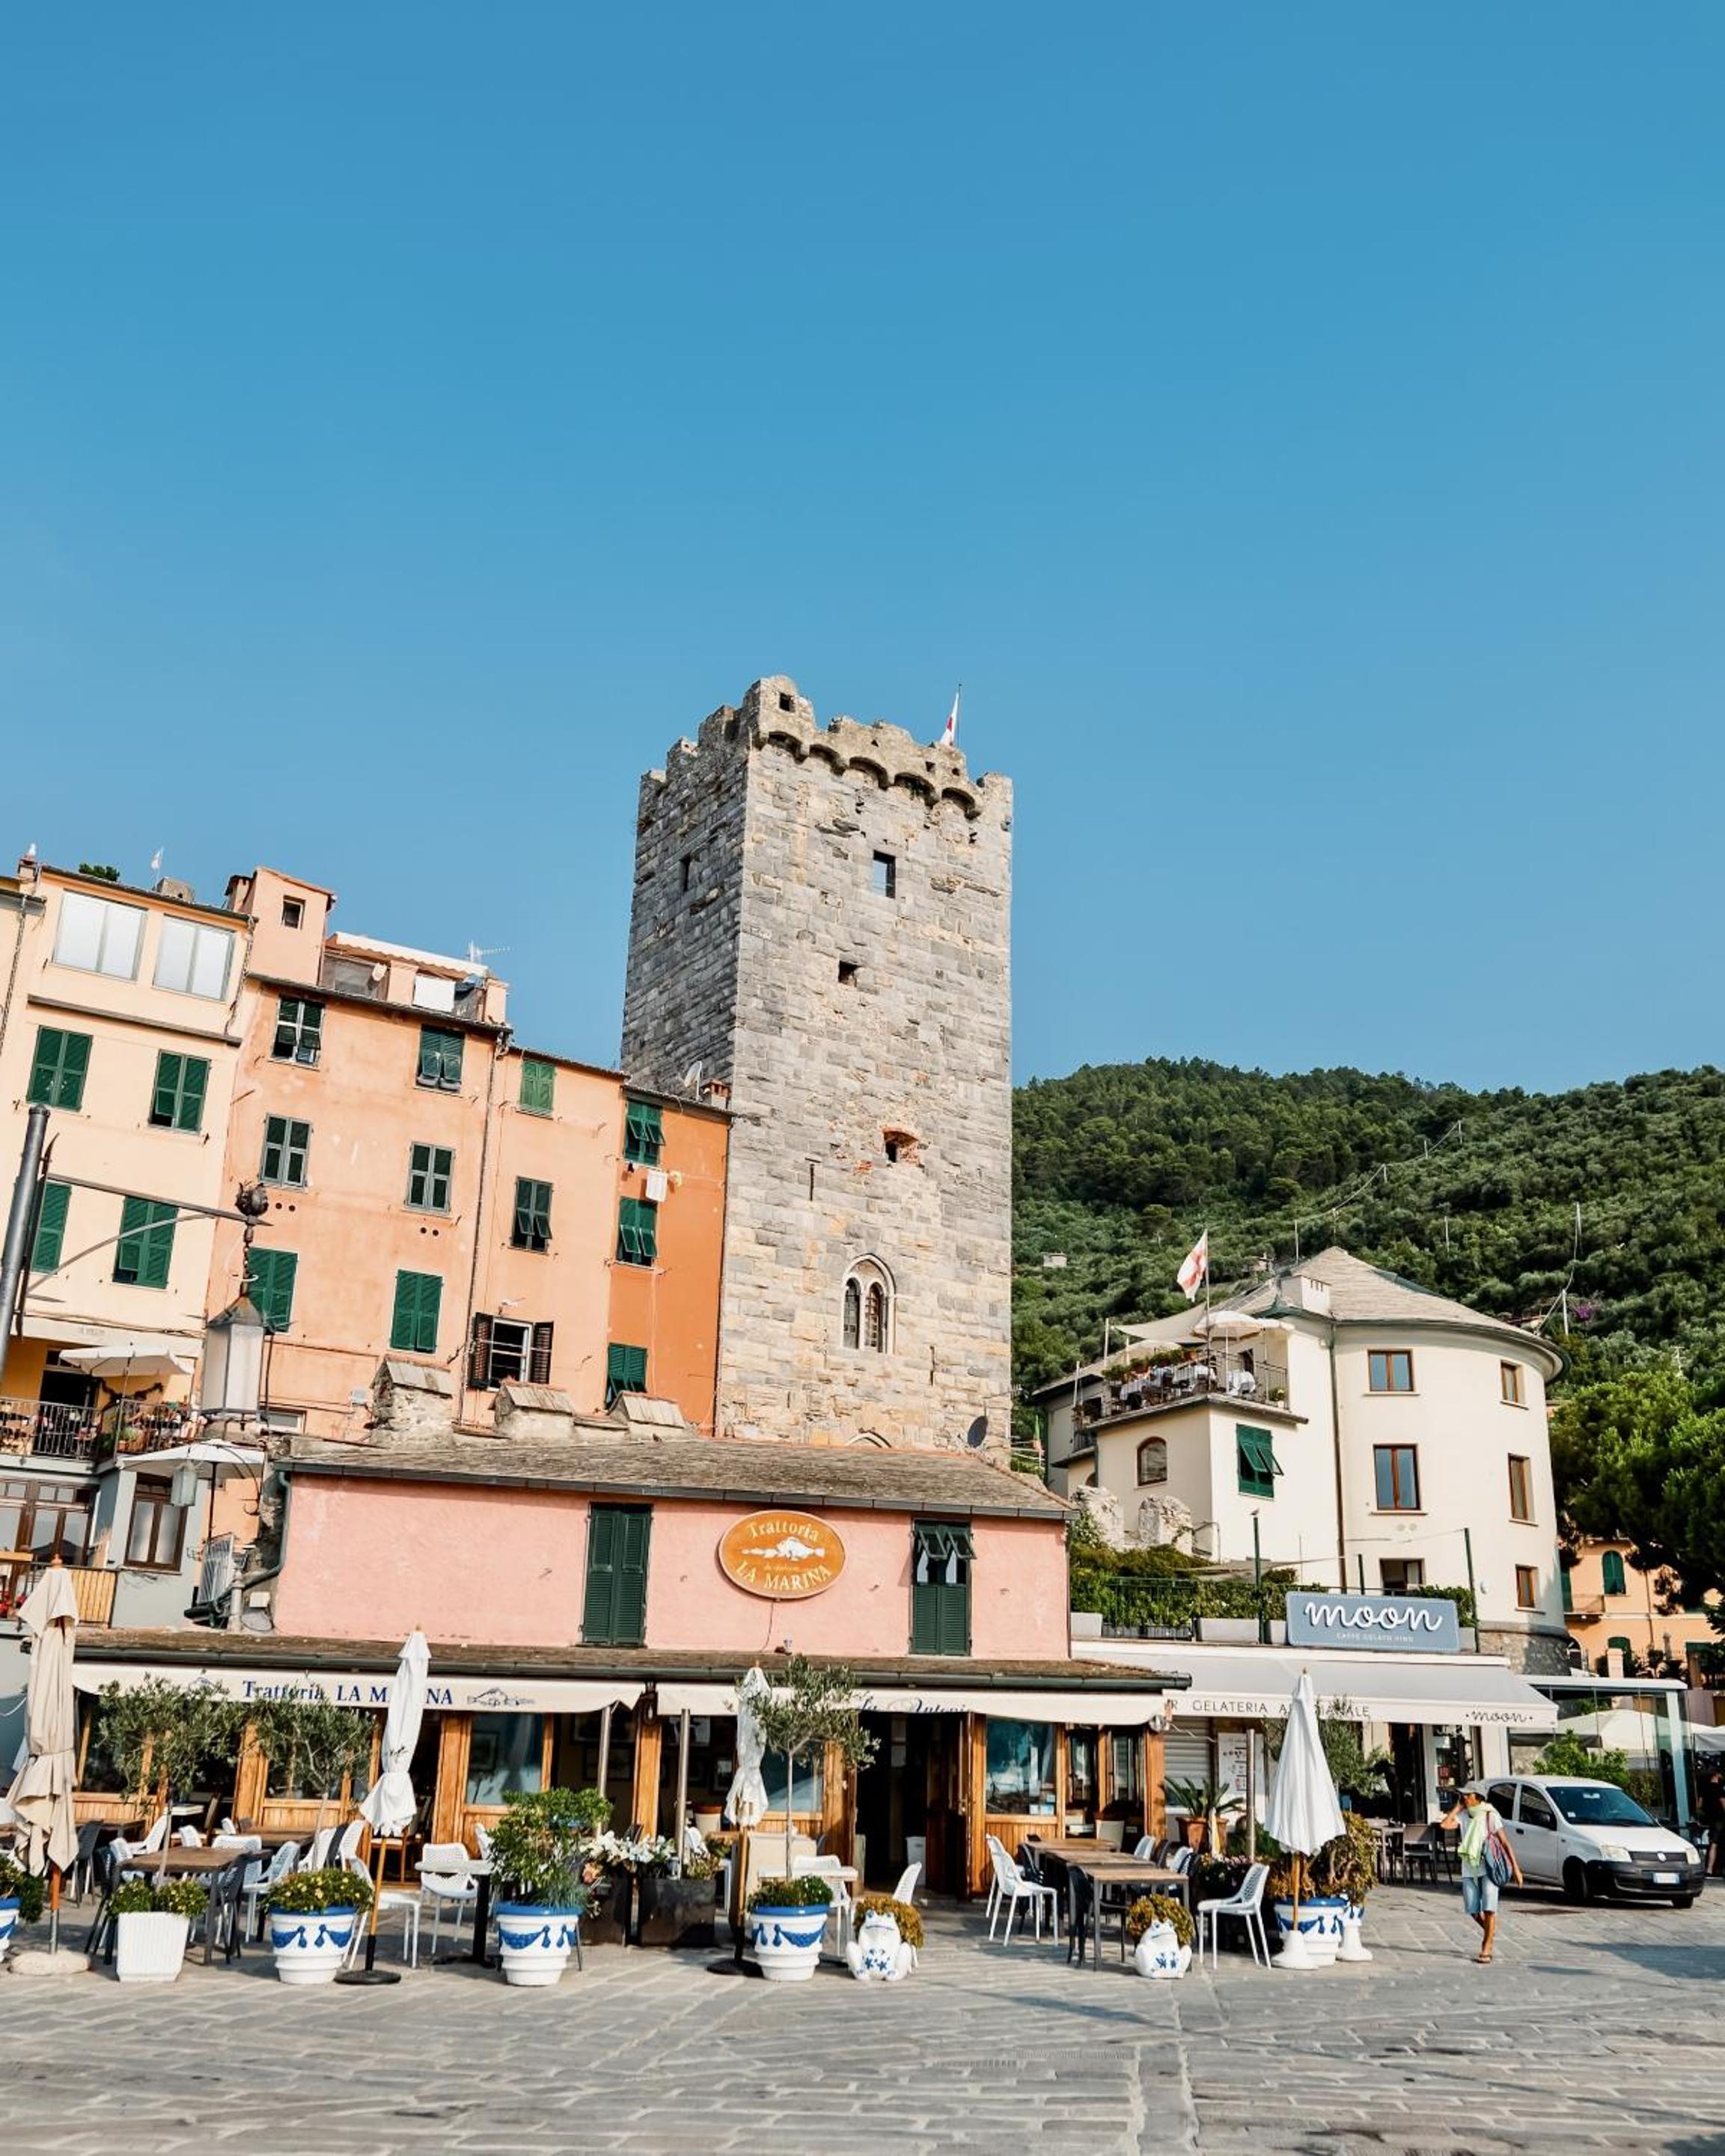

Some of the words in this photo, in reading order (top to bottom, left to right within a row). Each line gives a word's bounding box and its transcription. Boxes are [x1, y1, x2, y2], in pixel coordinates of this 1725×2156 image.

[747, 1519, 820, 1543] Trattoria
[736, 1560, 757, 1584] LA
[764, 1564, 833, 1591] MARINA
[1304, 1601, 1444, 1631] moon
[242, 1679, 326, 1702] Trattoria
[337, 1684, 361, 1702] LA
[370, 1686, 453, 1705] MNA
[1192, 1700, 1268, 1713] GELATERIA
[1471, 1710, 1527, 1723] moon
